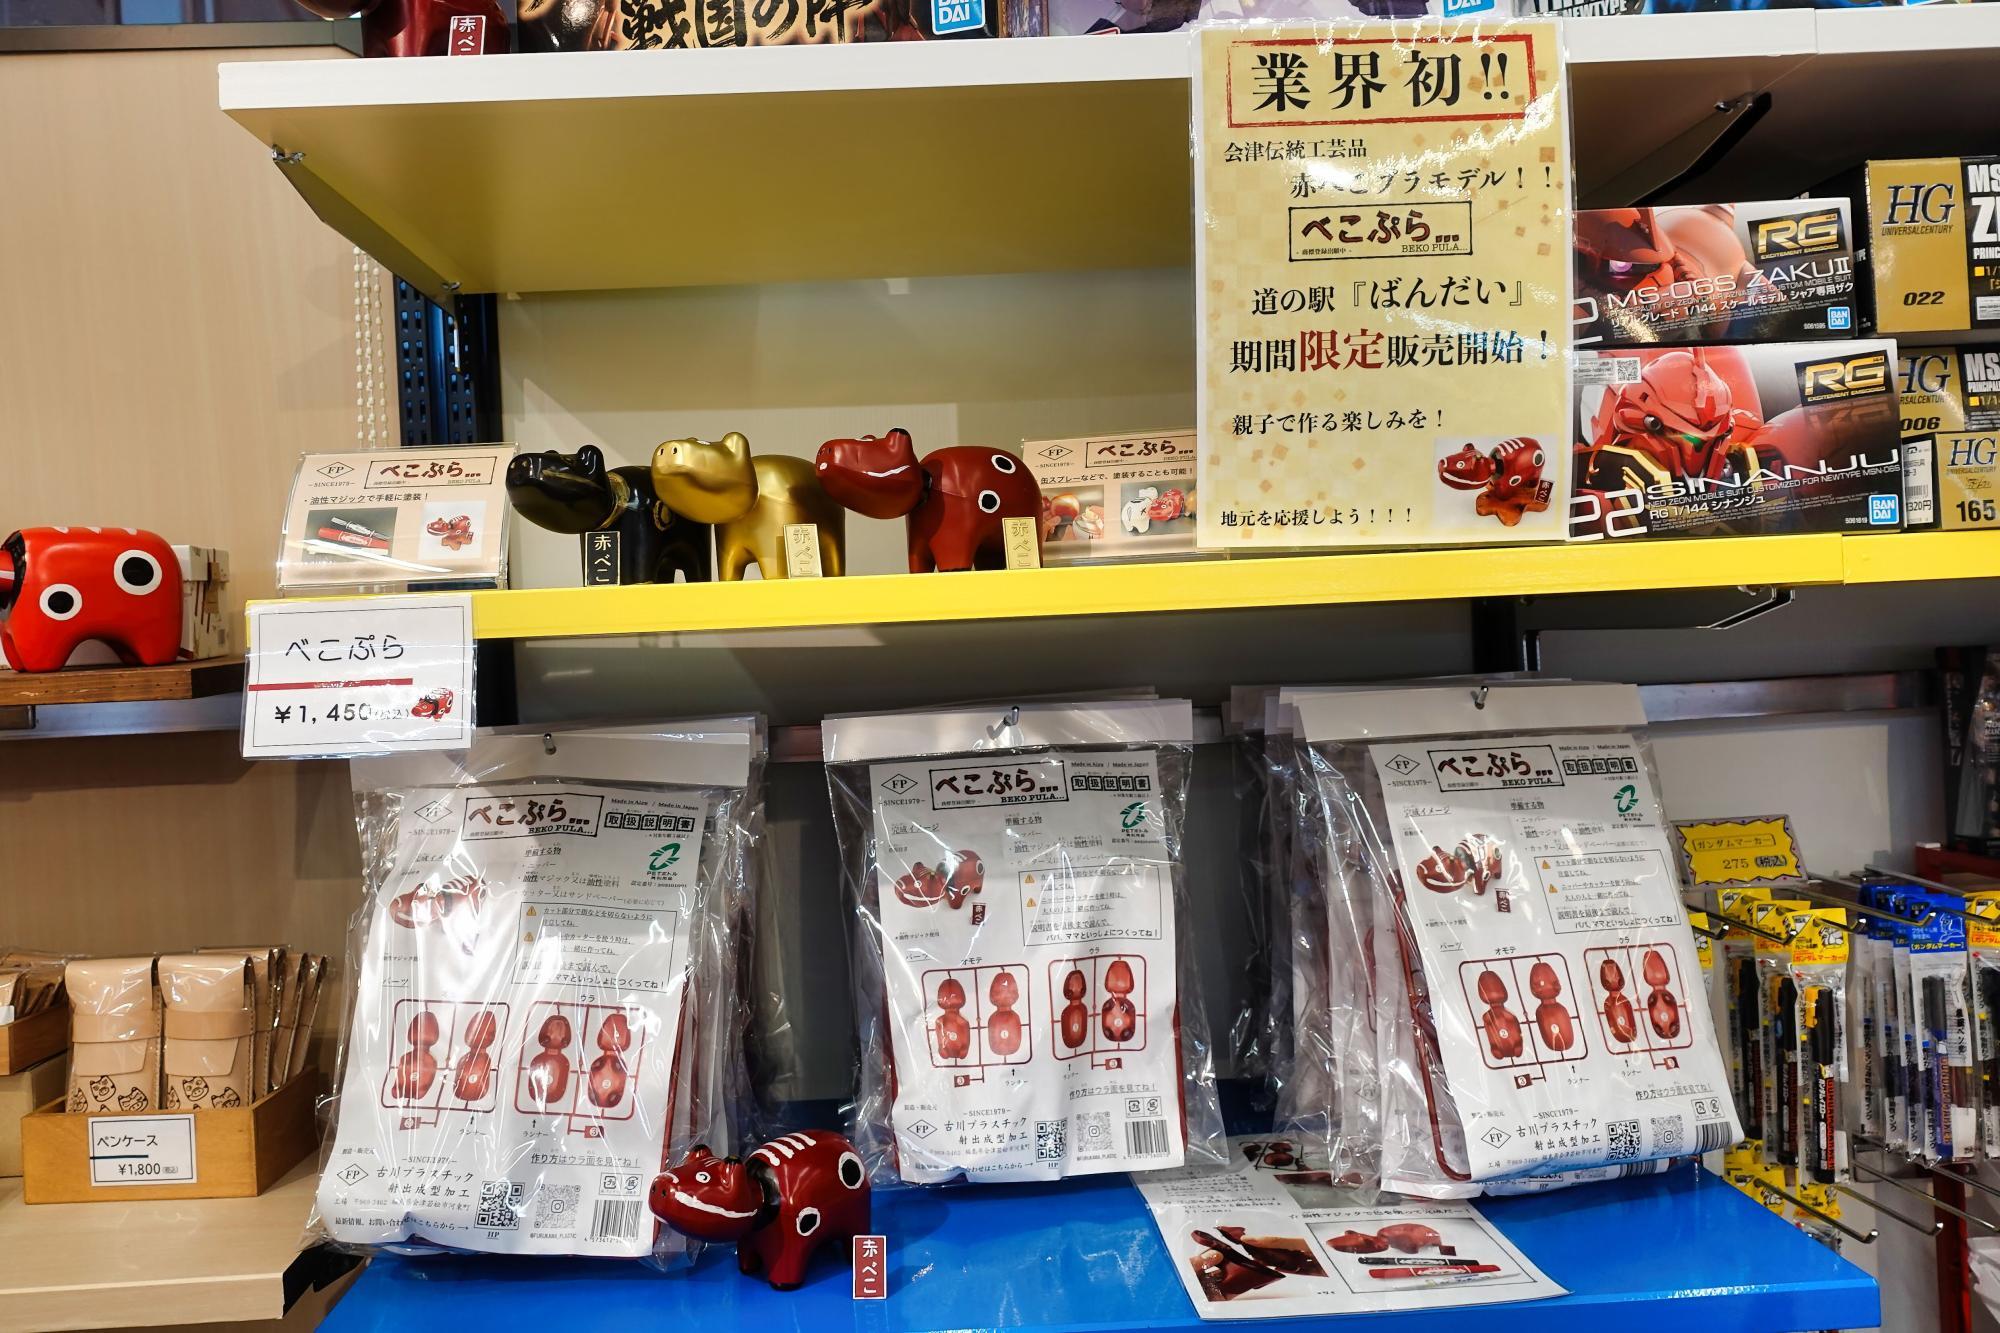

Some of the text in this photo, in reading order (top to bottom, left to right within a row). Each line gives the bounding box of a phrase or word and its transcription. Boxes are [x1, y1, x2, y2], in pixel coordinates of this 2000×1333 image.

[939, 6, 970, 24] DAI
[1224, 138, 1367, 163] 会津伝統工芸品
[1883, 184, 1955, 225] HG
[1759, 213, 1838, 254] RG
[1402, 244, 1430, 253] BEKO
[1804, 278, 1834, 288] MOBILE
[1836, 275, 1852, 284] SUIT
[1606, 274, 1738, 310] MS-06S
[1684, 281, 1854, 317] 1/144 スケールモデル シャア専用ザク
[1903, 291, 1945, 306] 022
[1831, 318, 1845, 326] DAI
[1230, 328, 1548, 374] 期間限定販売開始！
[1805, 357, 1886, 397] RG
[1232, 409, 1443, 435] 親子で作る楽しみを！
[1048, 449, 1063, 457] FP
[1947, 437, 1998, 466] HG
[327, 466, 345, 475] FP
[1647, 449, 1899, 501] SINANJU
[1668, 496, 1691, 506] ZEON
[1693, 490, 1724, 502] MOBILE
[1726, 487, 1744, 497] SUIT
[1746, 480, 1801, 495] CUSTOMIZED
[1803, 477, 1820, 486] FOR
[1821, 471, 1861, 484] NEWTYPE
[1650, 496, 1766, 520] RG 1/144 シナンジュ
[1873, 500, 1895, 510] BAN
[1956, 499, 1996, 522] 165
[1873, 509, 1891, 519] DAI
[793, 527, 813, 575] 赤べこ
[1012, 521, 1032, 567] 赤べこ
[594, 534, 611, 583] 赤べこ
[286, 634, 404, 662] べこぷら
[1395, 761, 1409, 770] FP
[892, 780, 908, 789] FP
[1502, 779, 1527, 787] BEKO
[528, 825, 553, 835] BEKO
[607, 814, 692, 830] 取扱説明書
[1723, 858, 1749, 870] 275
[1495, 947, 1516, 955] オモテ
[580, 994, 595, 1003] ウラ
[916, 1125, 929, 1134] FP
[944, 1117, 1027, 1132] 古川プラスチック
[1516, 1118, 1597, 1138] 古川プラスチック
[97, 1134, 158, 1148] ペンケース
[959, 1132, 1028, 1145] 射出成型加工
[1490, 1133, 1502, 1142] FP
[1535, 1135, 1600, 1151] 射出成型加工
[345, 1169, 360, 1179] FP
[376, 1166, 474, 1182] 古川プラスチック
[388, 1183, 471, 1199] 射出成型加工
[862, 1238, 878, 1294] 赤べこ
